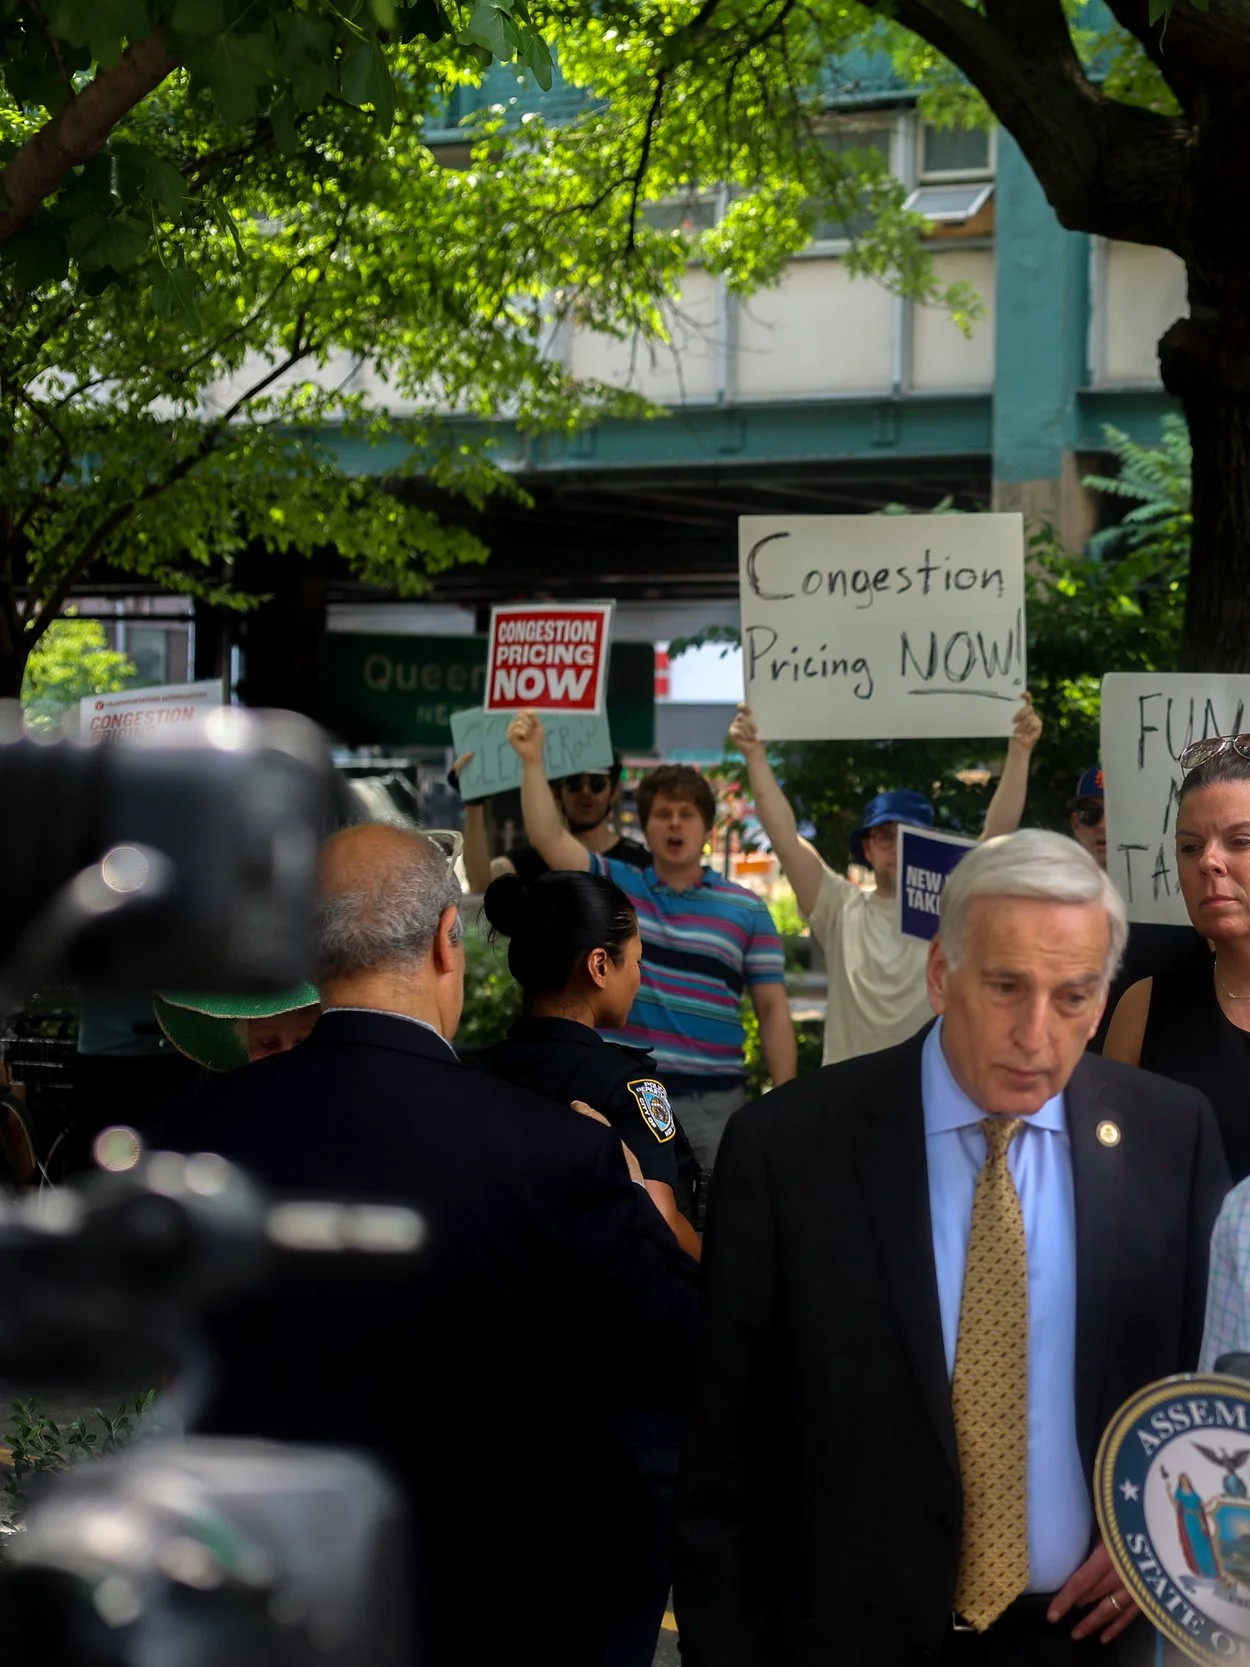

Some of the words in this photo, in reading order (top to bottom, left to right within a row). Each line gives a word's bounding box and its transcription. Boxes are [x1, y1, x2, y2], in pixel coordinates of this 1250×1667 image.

[746, 531, 1004, 610] Congestion
[498, 619, 598, 644] CONGESTION
[496, 644, 595, 666] PRICING
[745, 625, 874, 700] Pricing
[900, 608, 1022, 686] NOW!
[492, 667, 592, 702] NOW
[90, 707, 195, 731] CONGESTION
[906, 865, 942, 893] NEW
[639, 1097, 650, 1116] CITY
[1127, 1532, 1206, 1636] STATE
